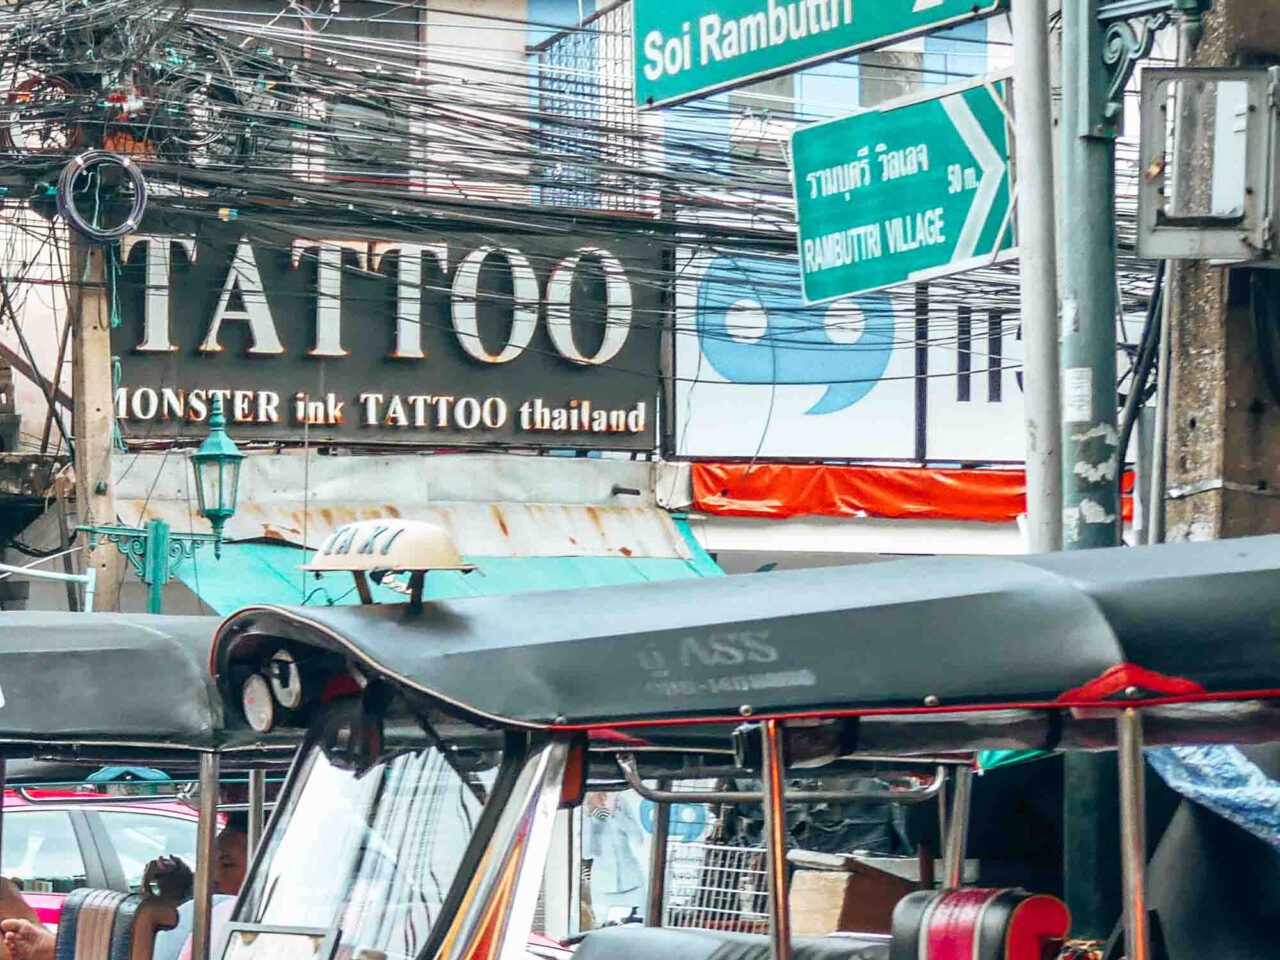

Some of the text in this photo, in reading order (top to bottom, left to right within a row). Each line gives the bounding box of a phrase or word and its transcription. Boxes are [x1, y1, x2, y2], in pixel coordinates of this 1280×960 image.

[643, 22, 691, 81] Soi
[806, 143, 929, 201] รามบุตรี วิลเลจ
[804, 208, 946, 273] RAMBUTTRI VILLAGE
[120, 234, 632, 366] TATTOO
[296, 391, 344, 424] ink
[360, 393, 507, 430] TATTOO
[520, 399, 646, 433] thailand
